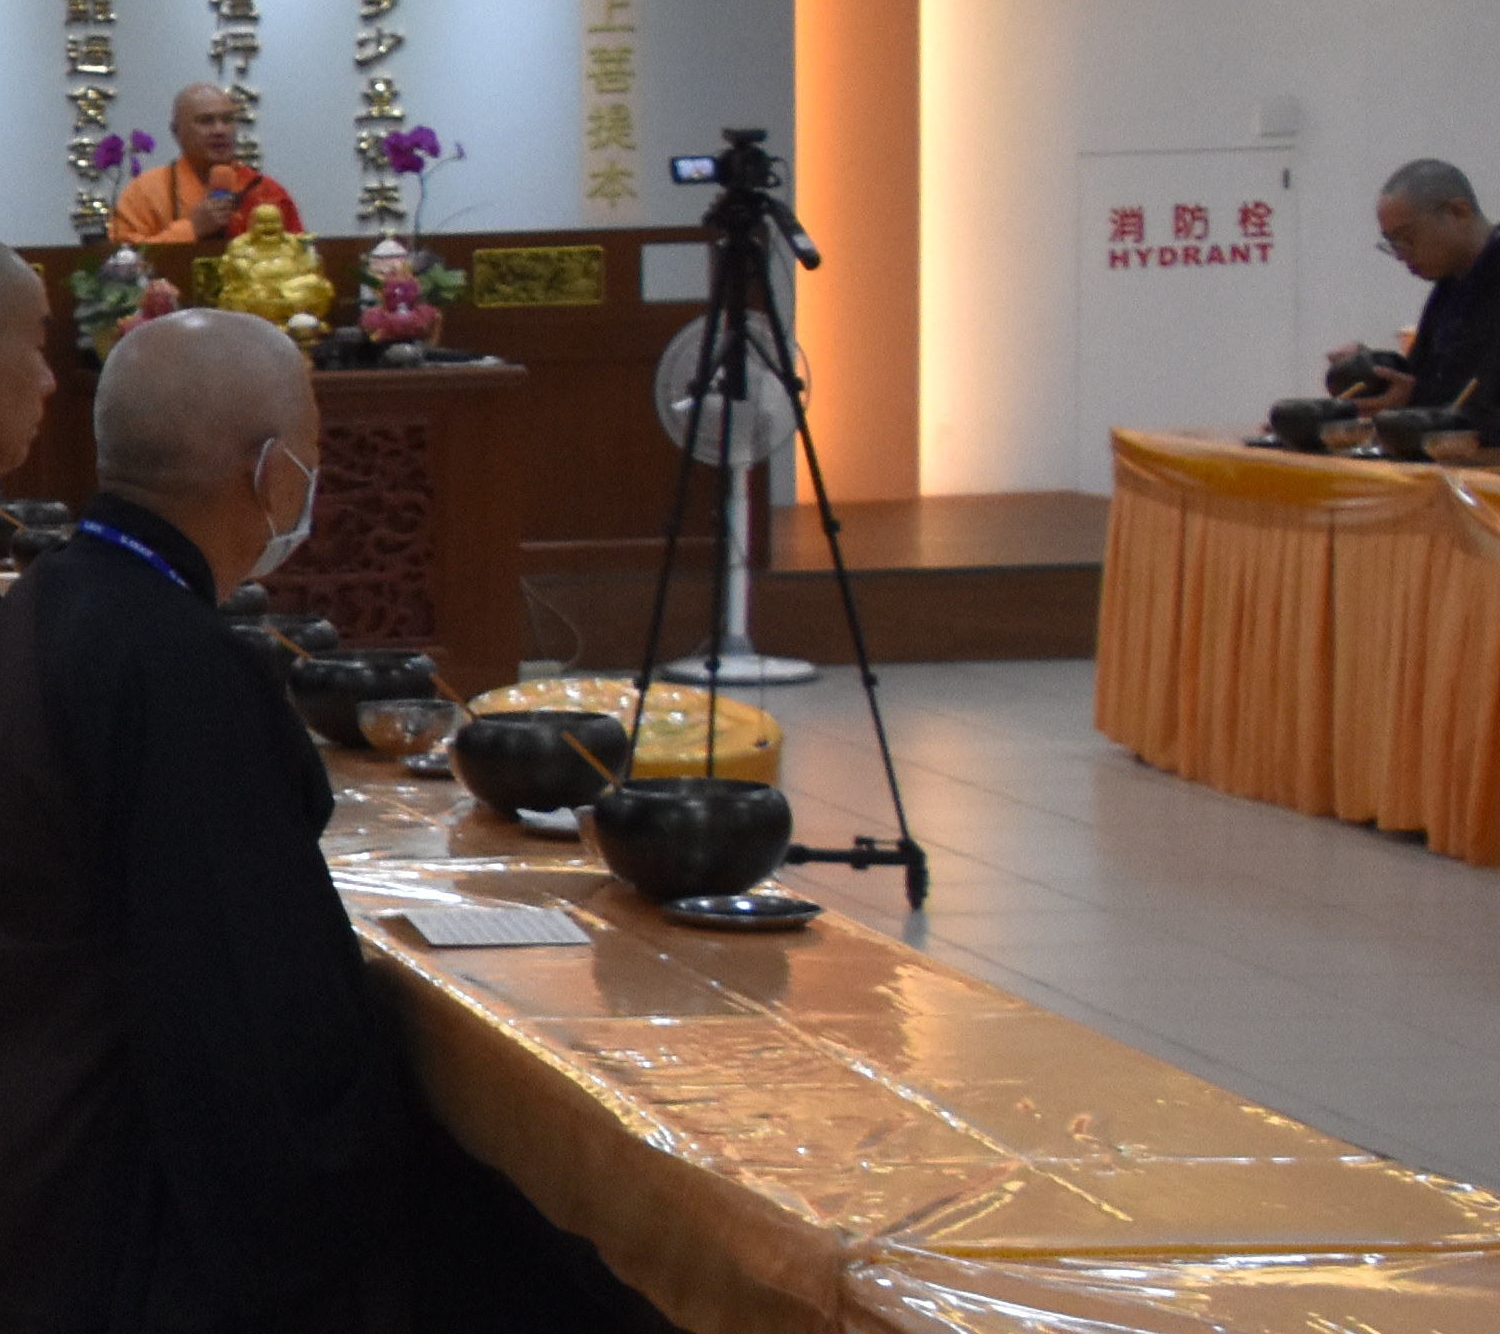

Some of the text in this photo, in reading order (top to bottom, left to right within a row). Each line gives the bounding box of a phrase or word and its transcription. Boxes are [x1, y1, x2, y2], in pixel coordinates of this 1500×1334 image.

[1109, 200, 1274, 243] 消防栓
[1108, 243, 1274, 269] HYDRANT
